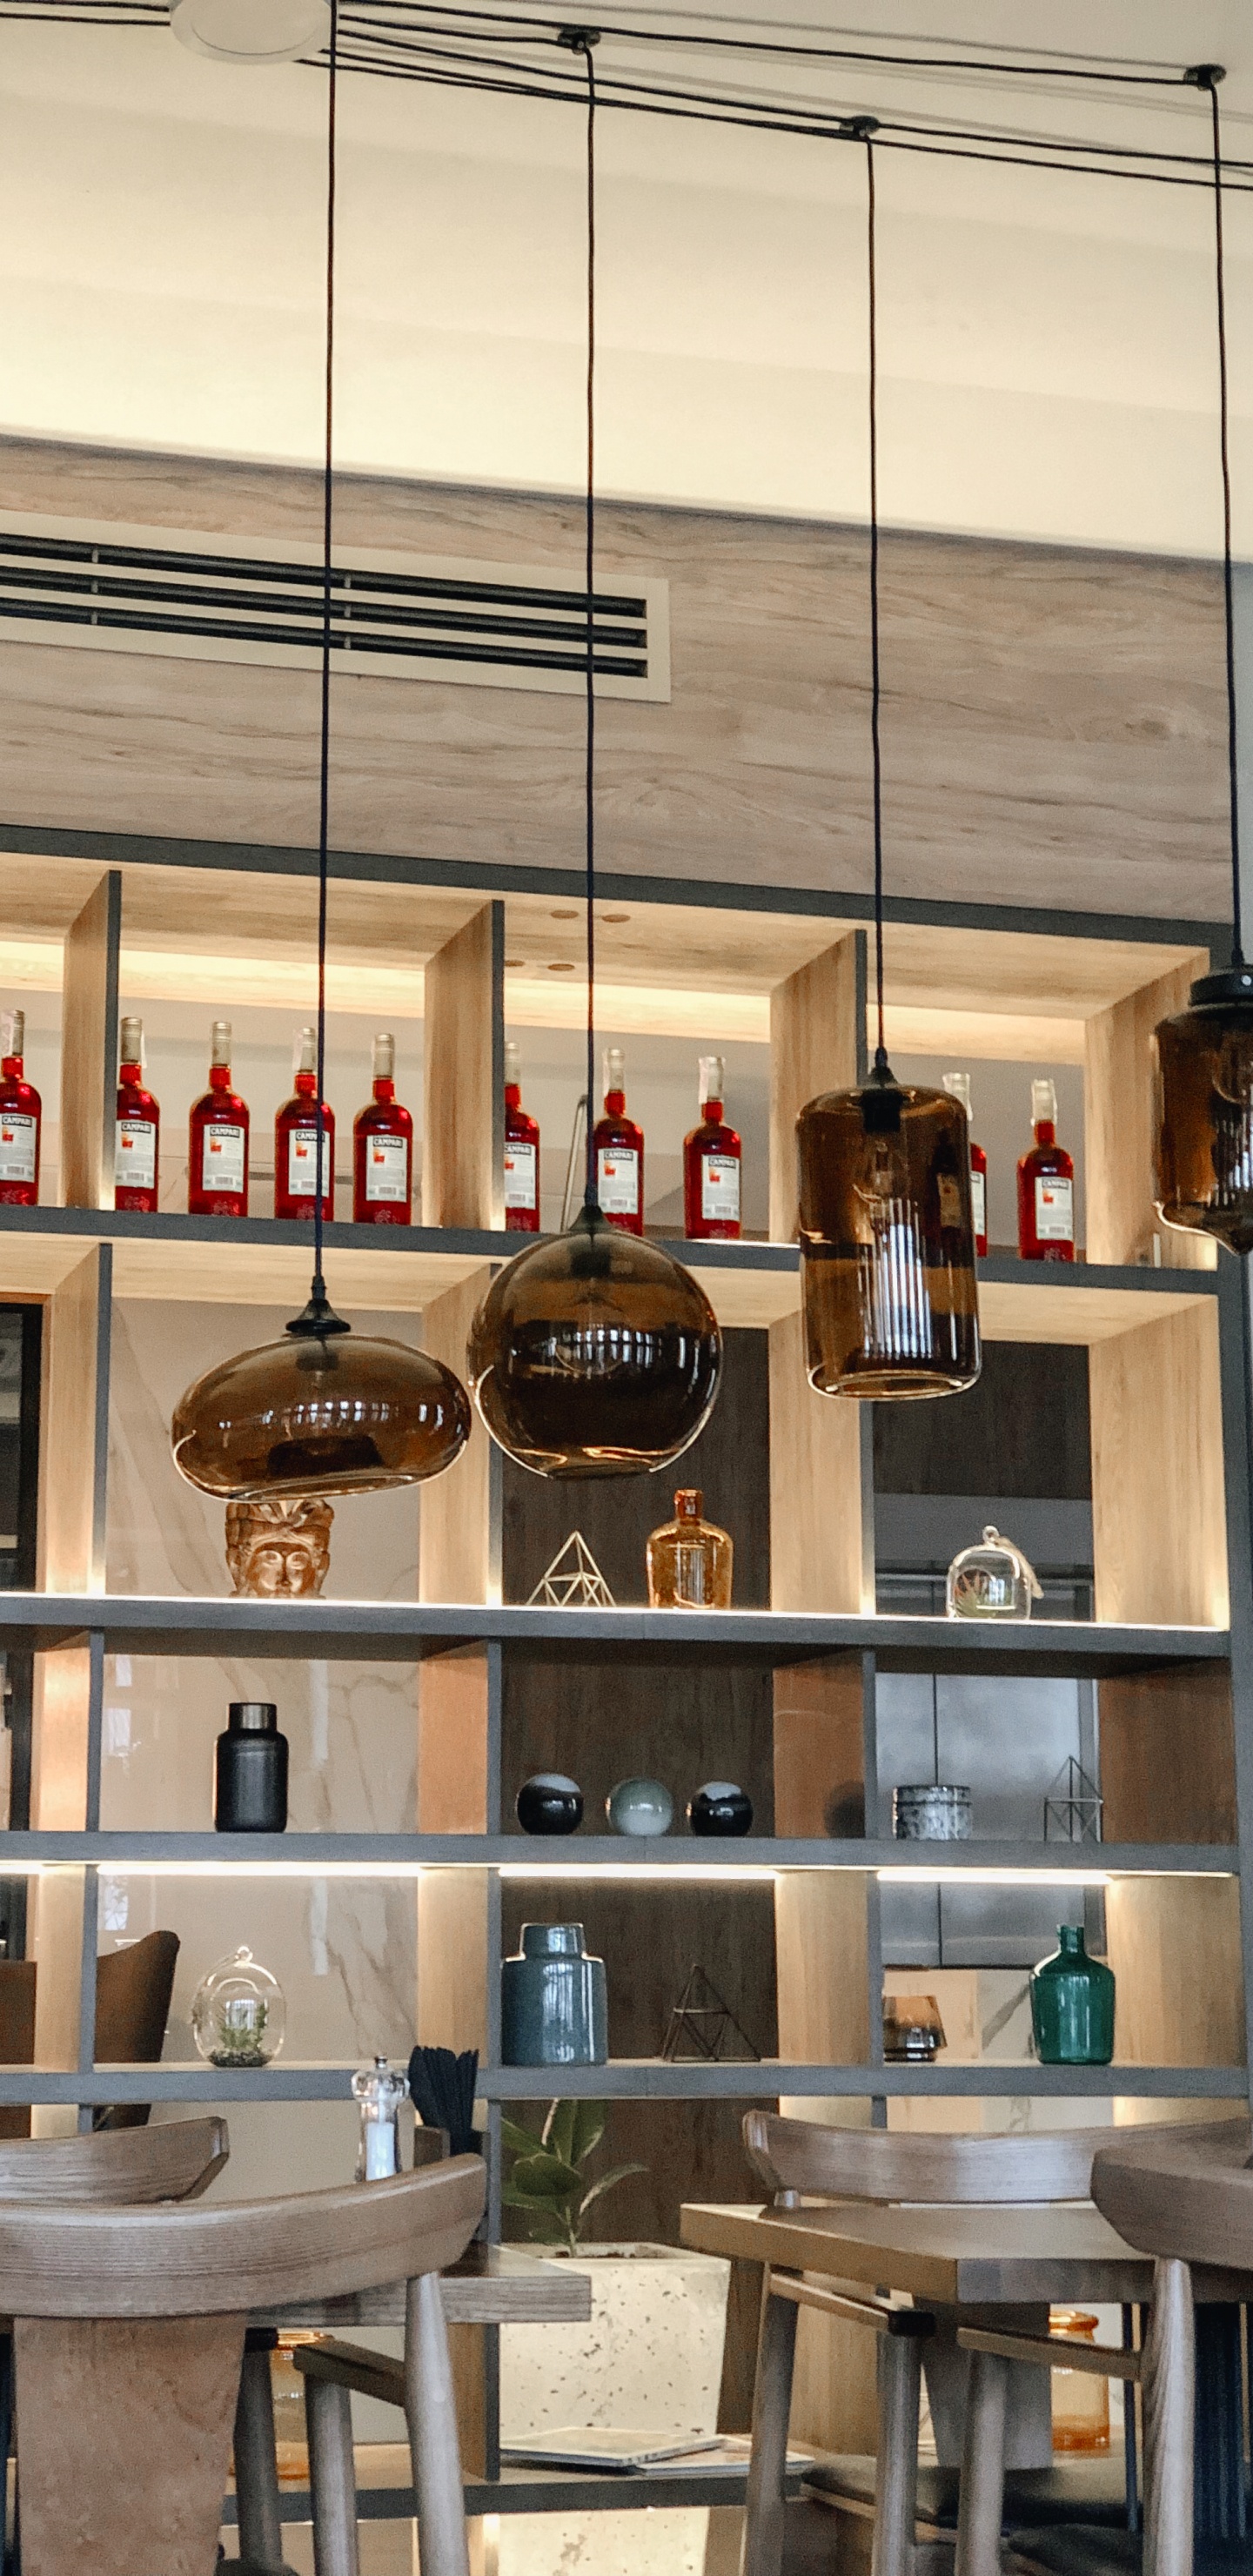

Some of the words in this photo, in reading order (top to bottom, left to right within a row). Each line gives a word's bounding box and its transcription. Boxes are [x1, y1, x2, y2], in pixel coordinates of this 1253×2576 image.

[3, 1117, 31, 1126] CAMPARI
[123, 1123, 151, 1132] CAMPARI
[211, 1127, 239, 1137] CAMPARI
[374, 1138, 402, 1148] CAMPARI
[604, 1150, 633, 1160] CAMPARI
[709, 1157, 735, 1167] CAMPARI
